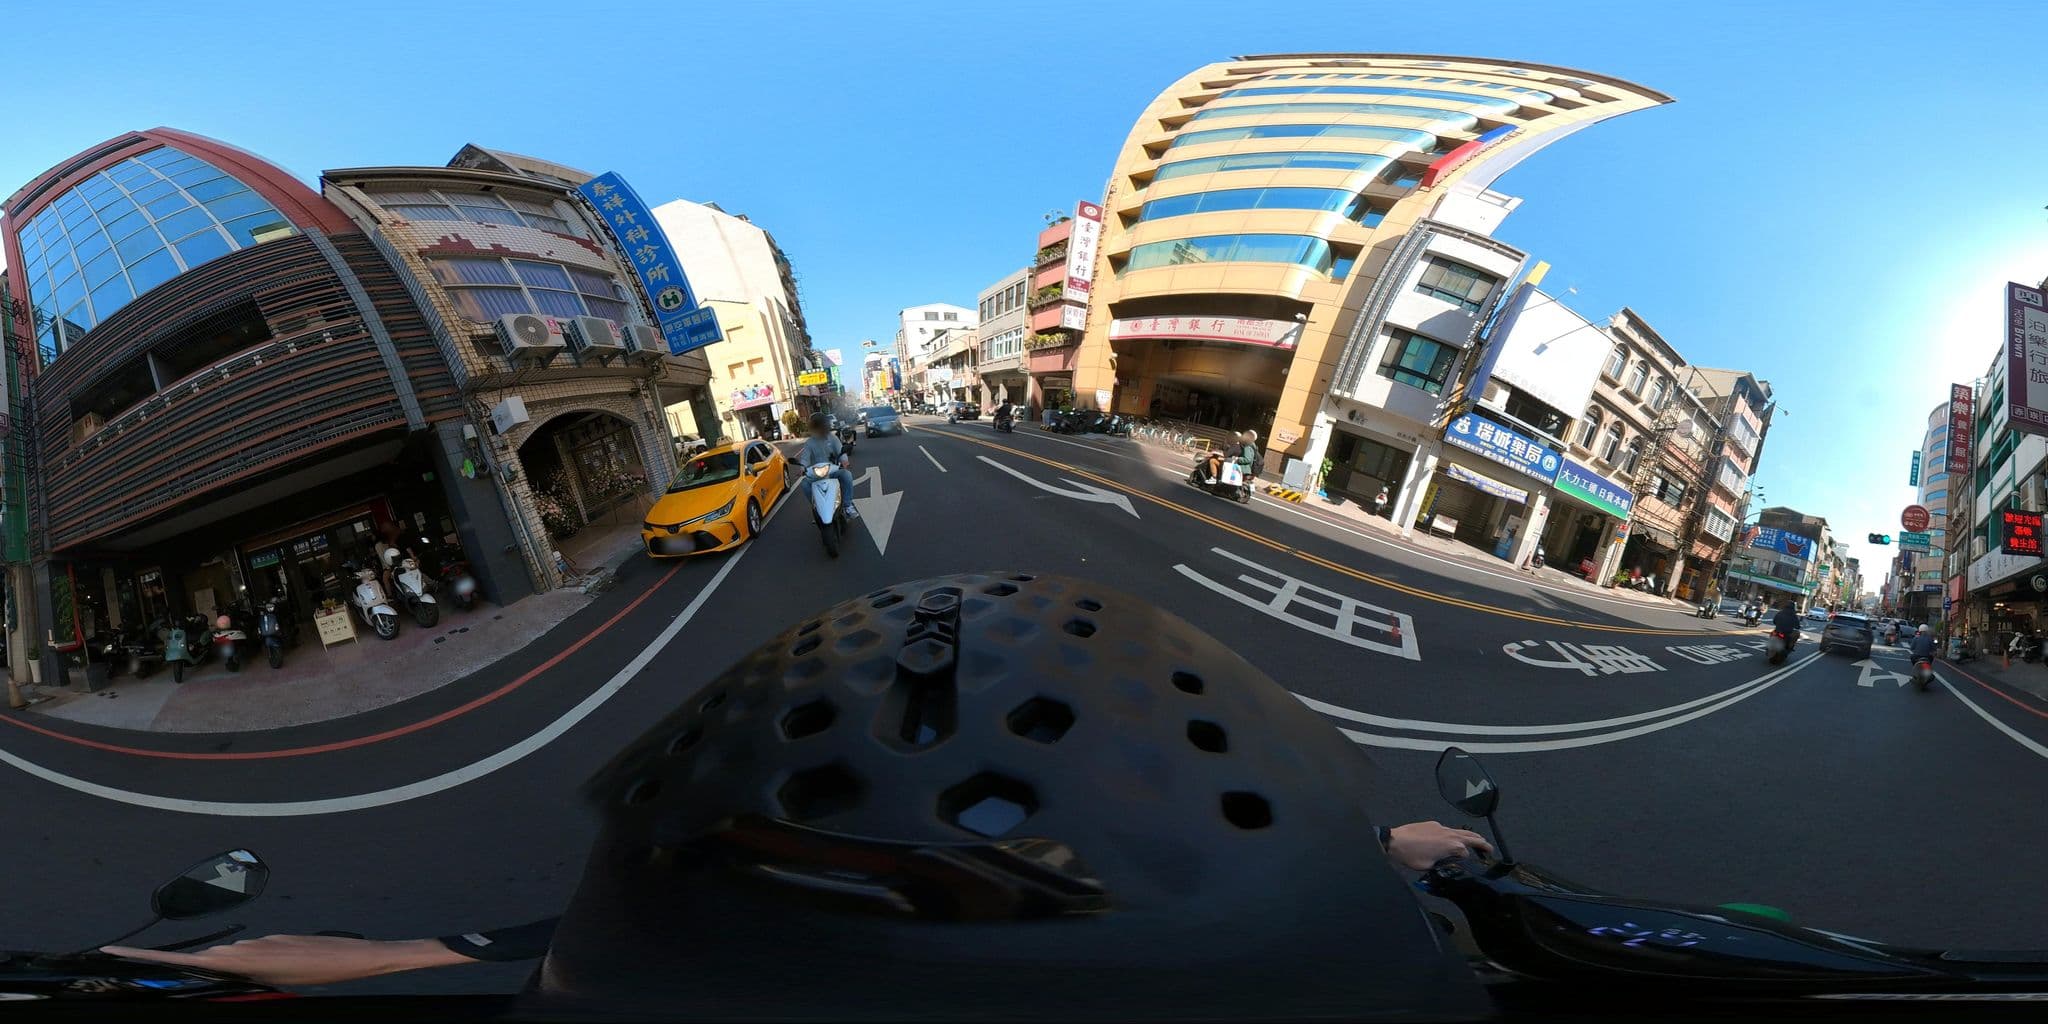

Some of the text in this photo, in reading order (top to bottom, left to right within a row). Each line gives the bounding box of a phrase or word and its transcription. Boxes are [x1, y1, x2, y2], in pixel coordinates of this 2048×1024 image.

[1074, 222, 1093, 278] 臺灣銀行
[1148, 318, 1226, 334] 臺灣銀行
[2014, 326, 2025, 359] Brown
[2028, 317, 2048, 387] 泊樂行旅
[1474, 421, 1544, 465] 瑞城藥局
